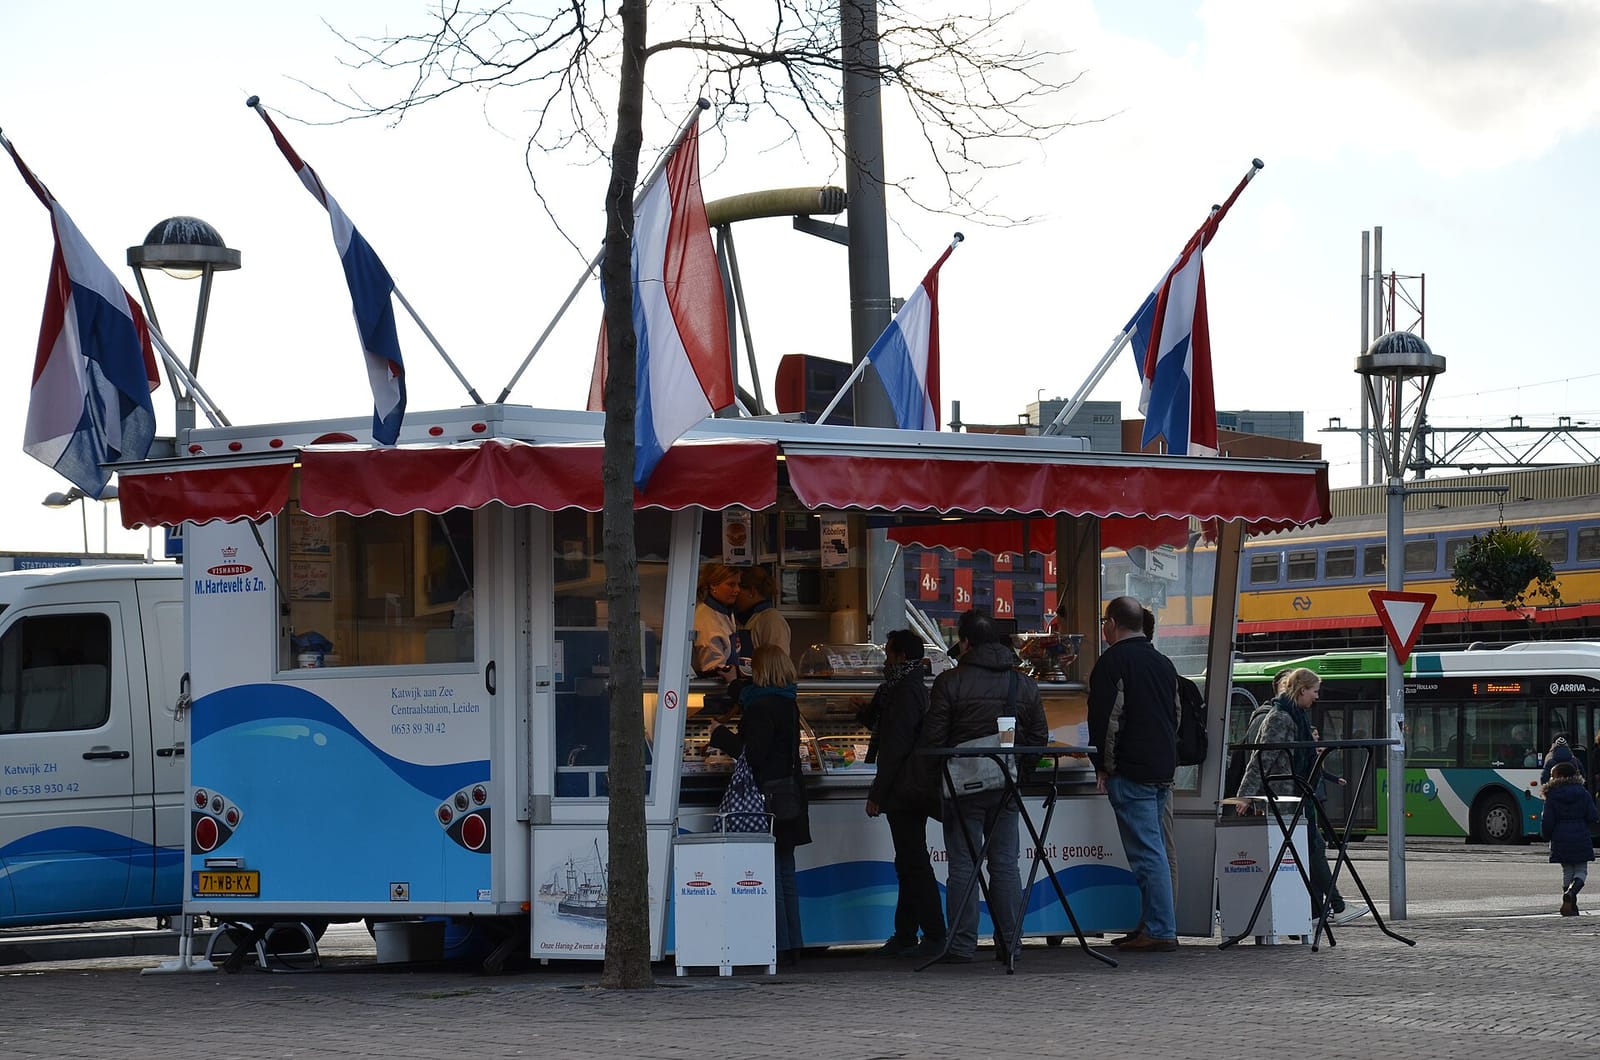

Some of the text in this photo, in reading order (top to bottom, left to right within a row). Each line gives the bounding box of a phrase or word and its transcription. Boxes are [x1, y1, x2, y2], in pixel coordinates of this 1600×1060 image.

[1280, 551, 1286, 564] 1
[211, 565, 248, 576] VISHANDEL
[195, 576, 267, 595] M.Hartevelt & Zn.
[922, 573, 938, 592] 4b
[956, 586, 971, 603] 3b
[996, 597, 1011, 614] 2b
[391, 686, 454, 701] Katwijk aan Zee
[1558, 683, 1587, 692] ARRIVA
[391, 702, 480, 715] Centraalstation, Leiden
[391, 722, 446, 735] 0653 89 30 42
[4, 763, 57, 776] Katwijk ZH
[5, 782, 80, 796] 06-538 930 42
[1062, 844, 1114, 861] genoeg...
[202, 875, 252, 890] 71-WB-KX
[540, 942, 554, 950] Onze
[555, 941, 574, 951] Haring
[574, 942, 593, 950] Zwemt
[593, 942, 600, 950] in
